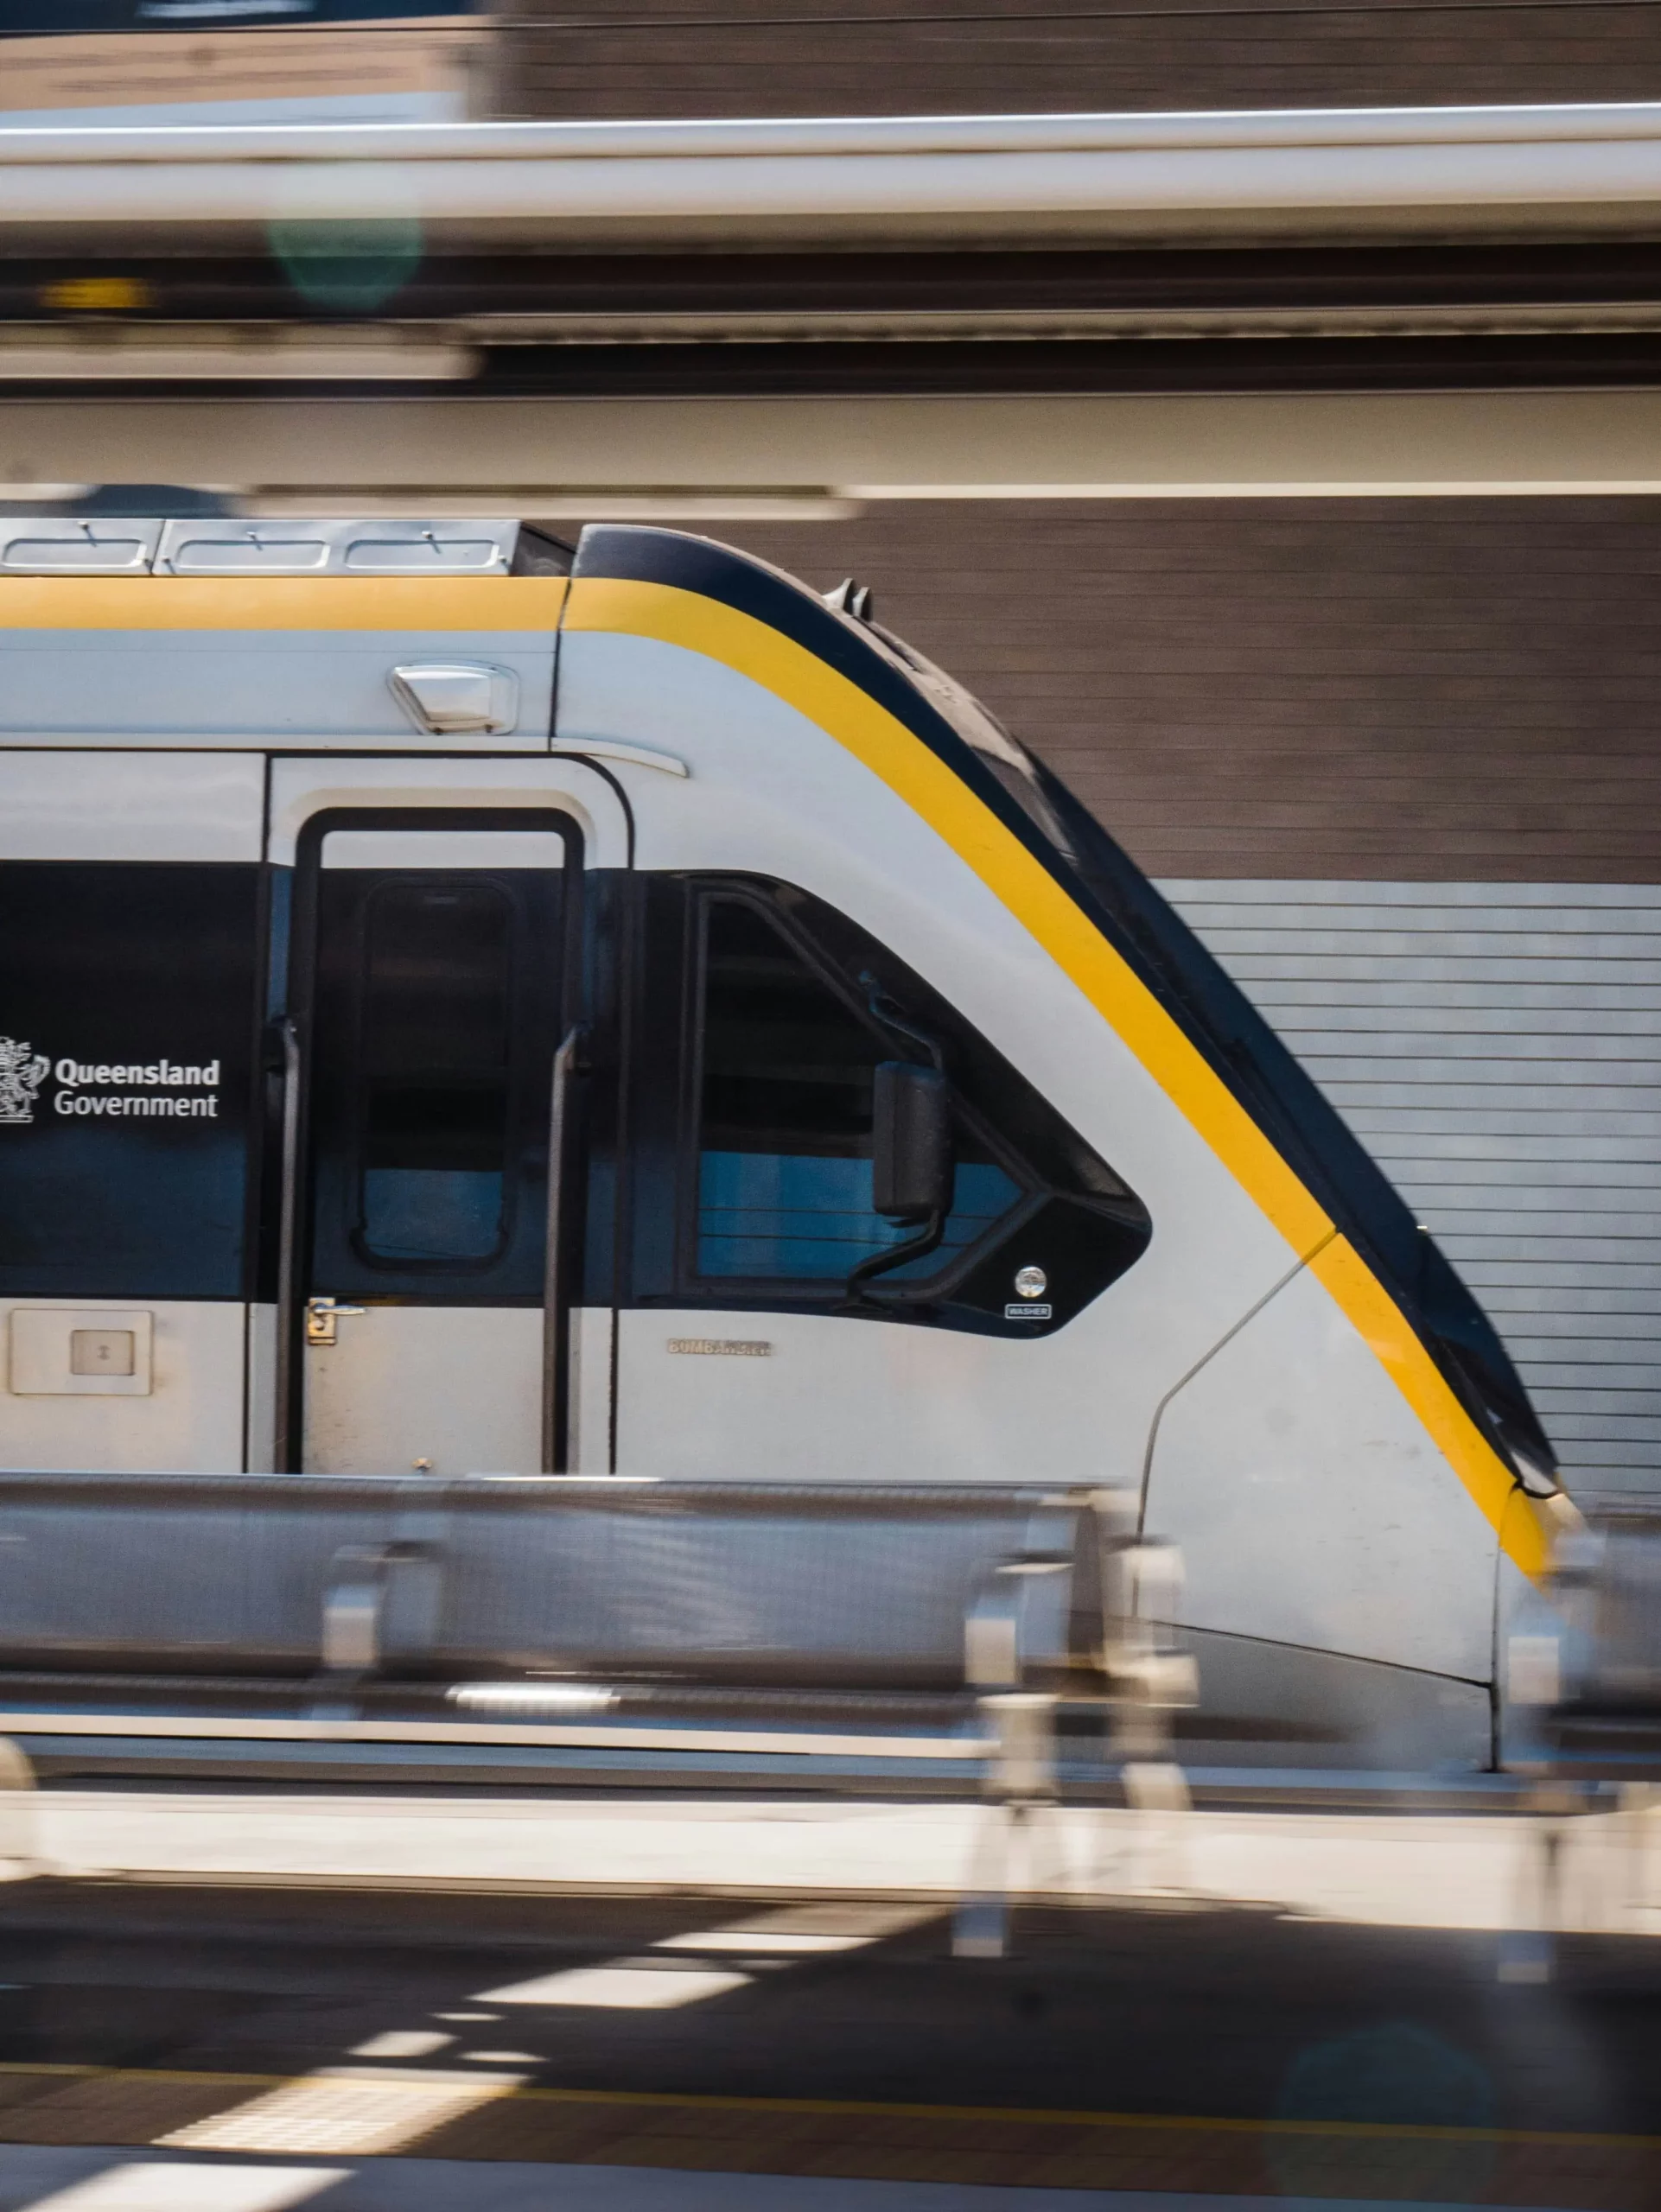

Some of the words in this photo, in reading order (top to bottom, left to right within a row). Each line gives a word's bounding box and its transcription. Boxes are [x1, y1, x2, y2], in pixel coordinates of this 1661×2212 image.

[54, 1058, 220, 1087] Queensland
[54, 1090, 219, 1116] Government
[668, 1339, 774, 1355] BOMBADE
